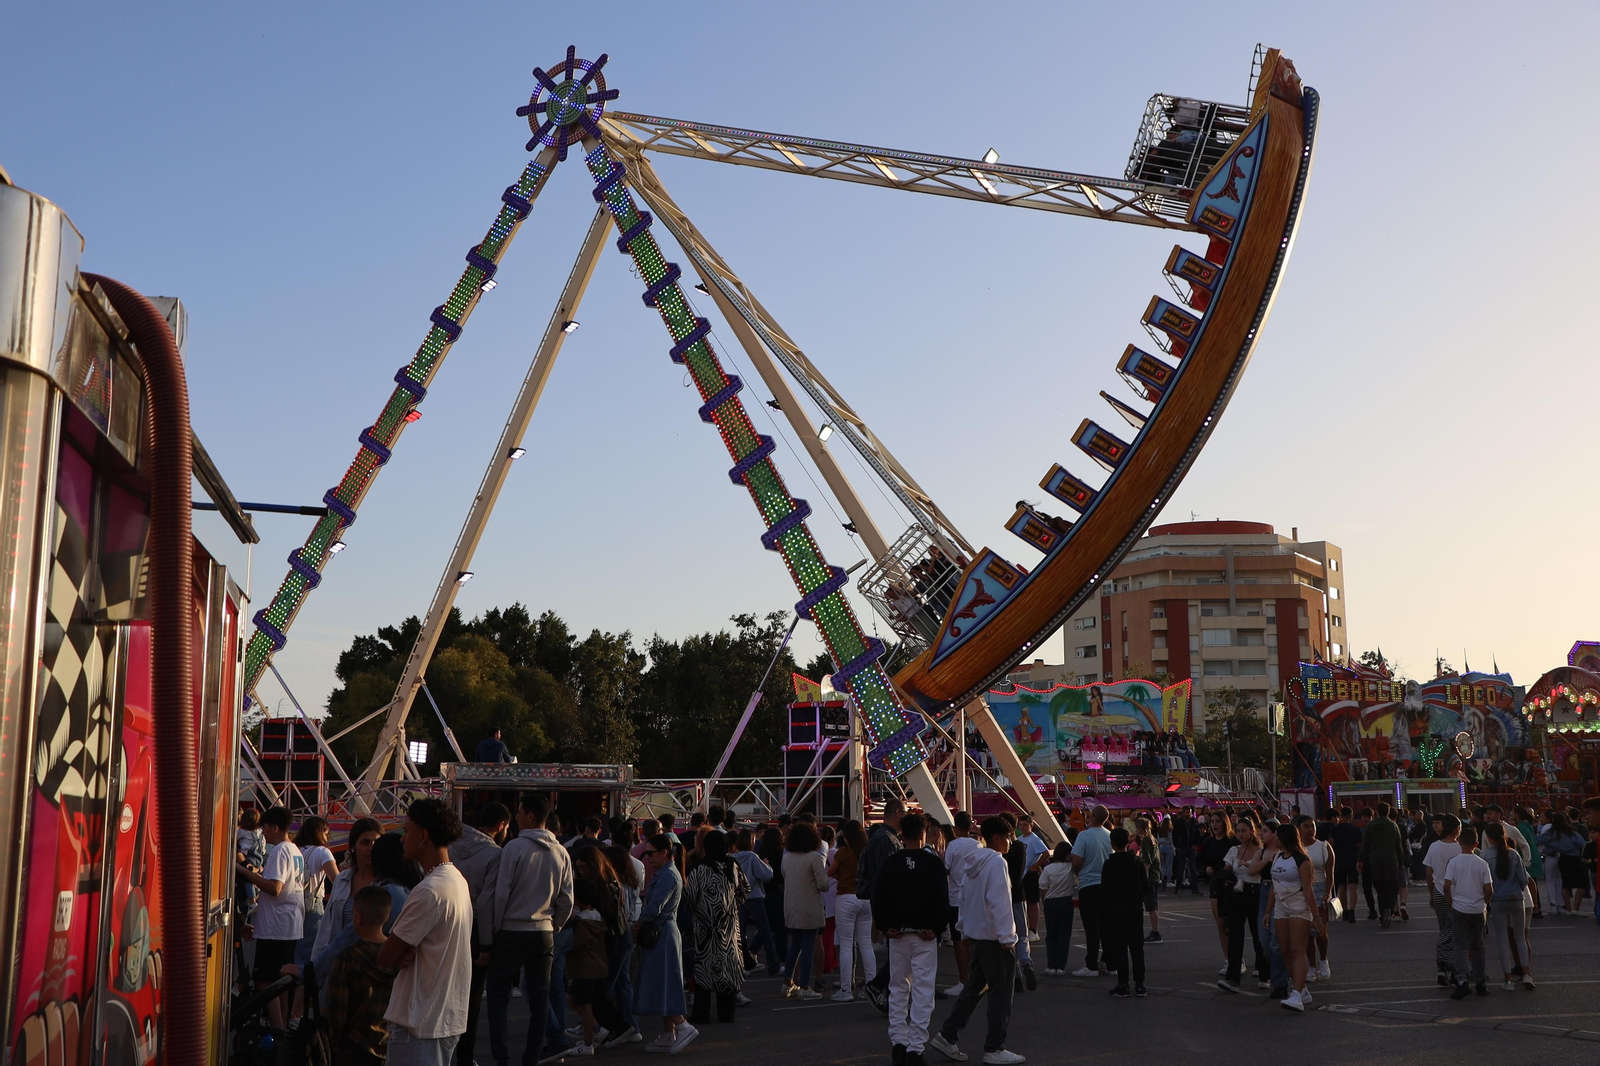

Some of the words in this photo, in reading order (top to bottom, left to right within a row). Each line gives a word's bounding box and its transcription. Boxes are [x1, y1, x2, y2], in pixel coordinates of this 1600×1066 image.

[1307, 677, 1402, 702] CABALLO
[1445, 684, 1497, 705] LOCO
[1168, 696, 1179, 734] ALO
